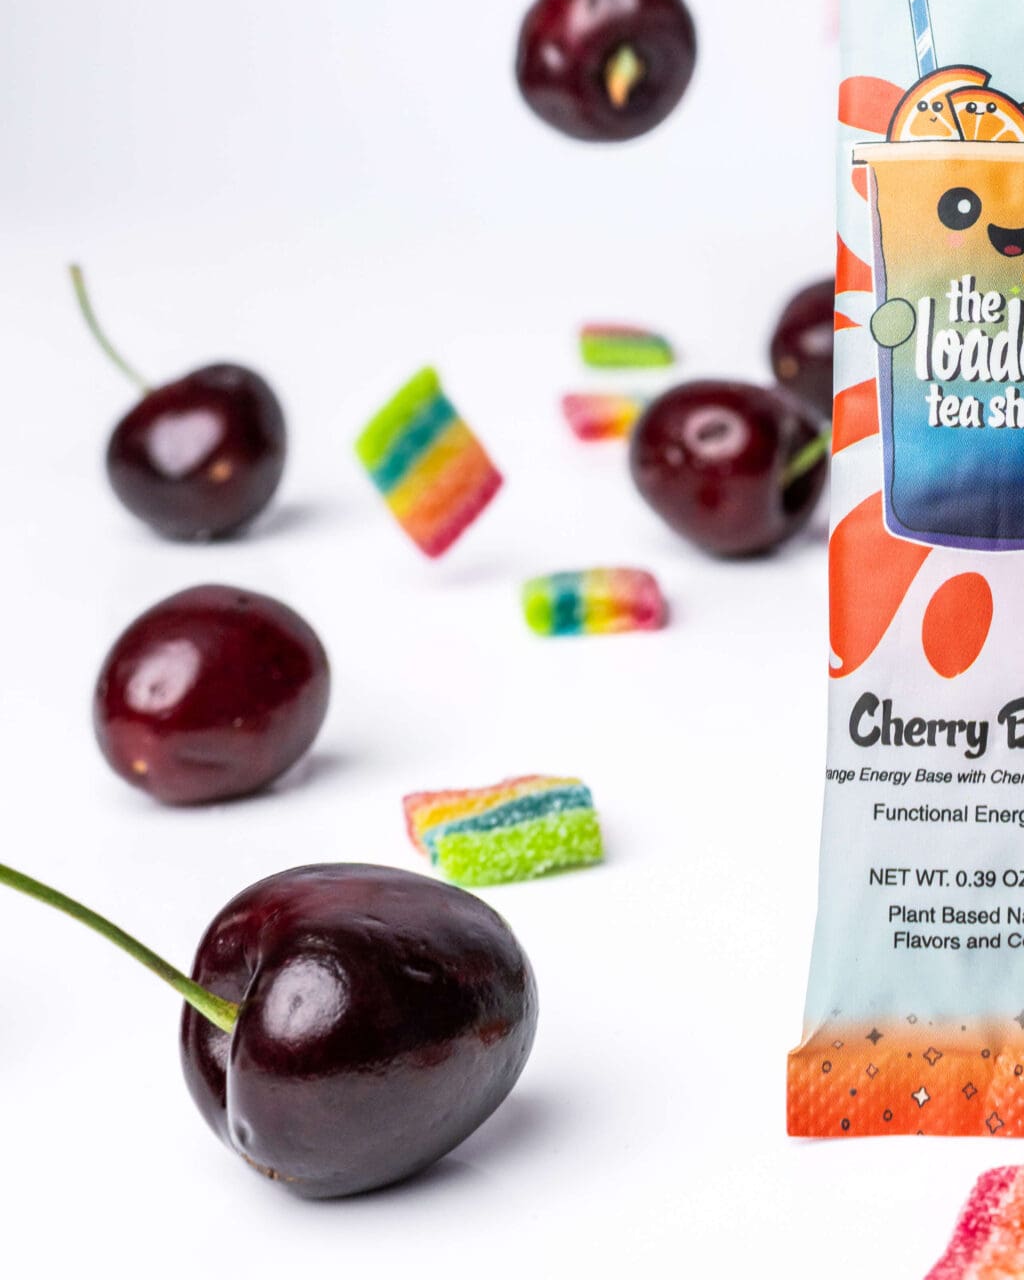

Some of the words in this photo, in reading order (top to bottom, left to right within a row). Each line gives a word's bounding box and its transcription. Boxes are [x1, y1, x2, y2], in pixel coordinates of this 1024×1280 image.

[945, 273, 1006, 324] the
[925, 383, 984, 428] tea
[848, 691, 989, 760] Cherry
[859, 767, 911, 786] Energy
[914, 768, 953, 784] Base
[956, 769, 986, 784] with
[873, 803, 969, 823] Functional
[869, 868, 911, 886] NET
[915, 869, 950, 887] WT.
[955, 870, 997, 888] 0.39
[888, 905, 936, 923] Plant
[942, 906, 1001, 925] Based
[893, 931, 961, 949] Flavors
[966, 932, 1001, 950] and
